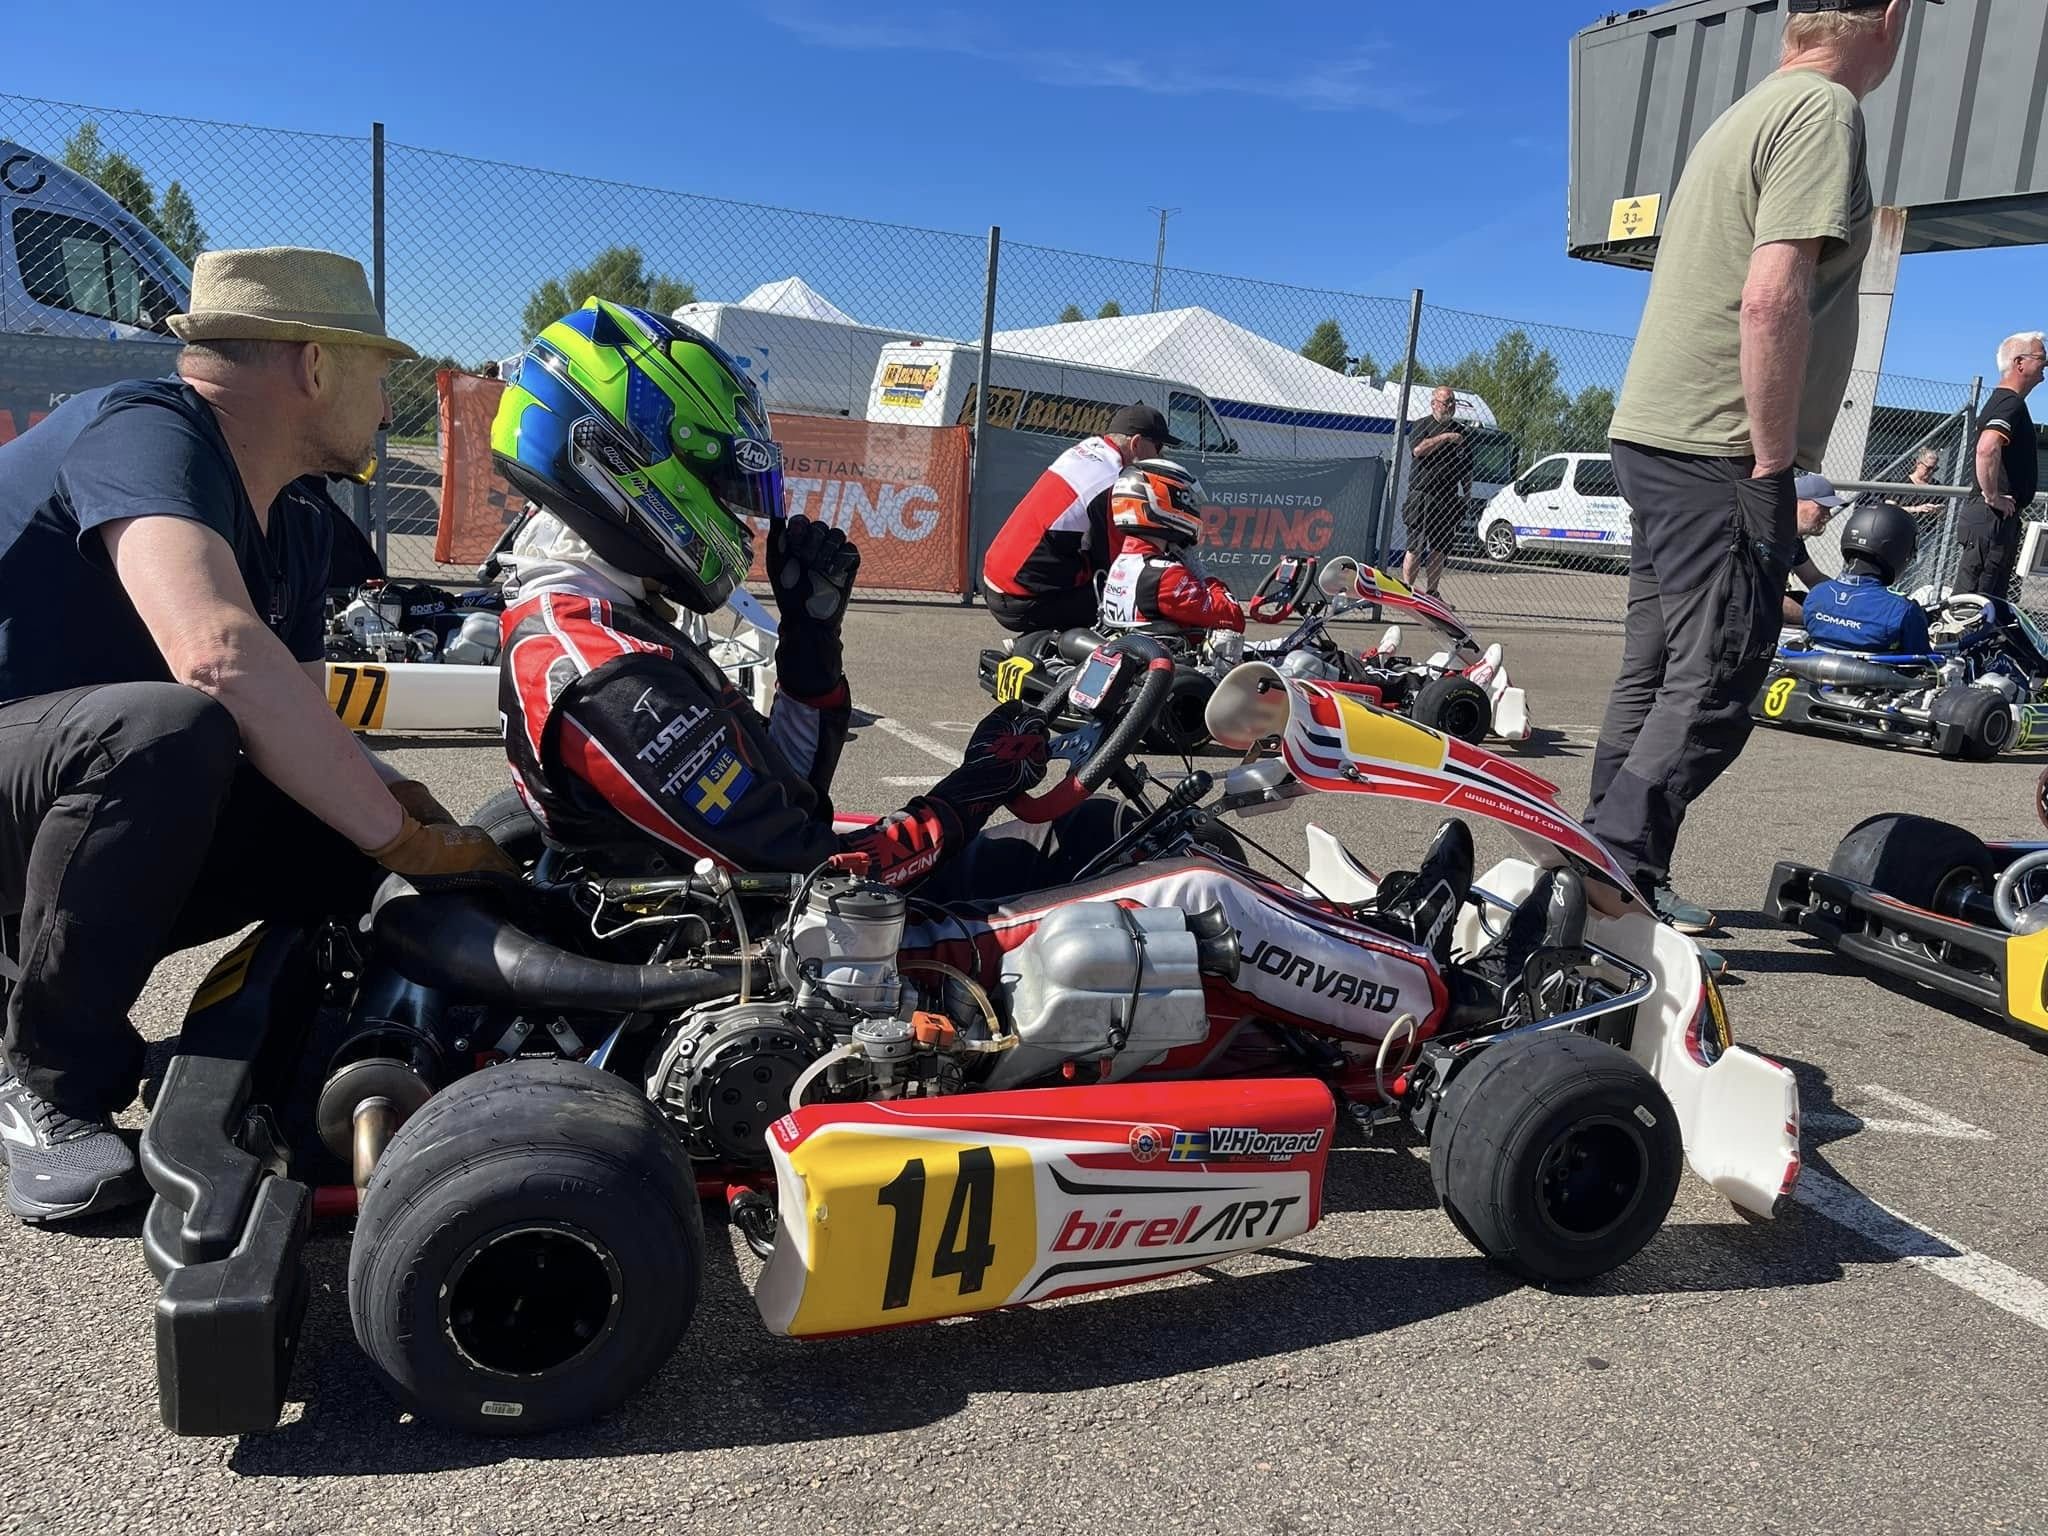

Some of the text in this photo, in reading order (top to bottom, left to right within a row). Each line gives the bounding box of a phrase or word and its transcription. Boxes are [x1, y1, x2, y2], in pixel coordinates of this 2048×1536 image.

[736, 443, 769, 465] Arai
[782, 457, 922, 480] RISTIANSTAD
[784, 476, 940, 541] TING
[1211, 491, 1322, 507] KRISTIANSTAD
[1198, 506, 1334, 552] RTING
[1199, 552, 1272, 565] LACE TO
[1766, 678, 1795, 715] 3
[710, 752, 733, 780] SWE
[1464, 791, 1564, 833] www.birelart.com
[1239, 940, 1400, 1013] JORVARD
[1210, 1127, 1325, 1155] V.Hjorvard
[877, 1146, 996, 1310] 14
[1048, 1195, 1301, 1253] birelART
